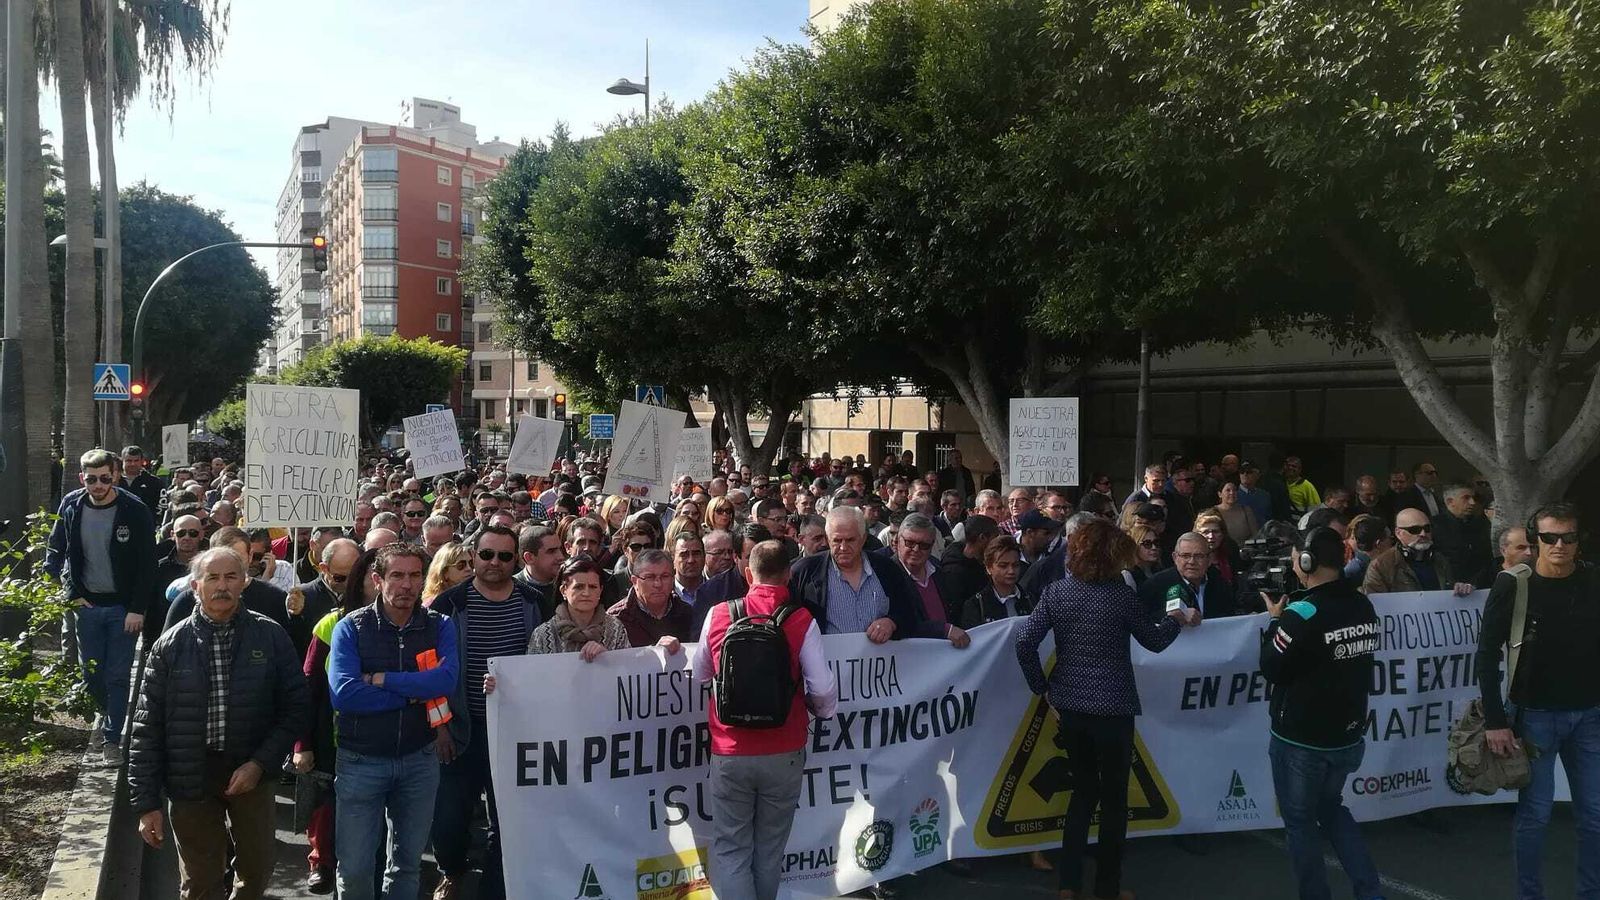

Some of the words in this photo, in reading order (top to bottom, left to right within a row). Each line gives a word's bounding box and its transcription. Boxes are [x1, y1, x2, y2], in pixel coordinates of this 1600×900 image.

[250, 391, 341, 421] NUESTRA
[1018, 407, 1074, 421] NUESTRA
[407, 411, 448, 431] NUESTRA
[1012, 425, 1077, 439] AGRICULTURA
[247, 427, 358, 459] AGRICULTURA
[1052, 441, 1067, 451] EN
[1015, 455, 1058, 467] PELIGRO
[1061, 457, 1075, 468] DE
[247, 464, 274, 490] EN
[282, 465, 355, 494] PELIGRO
[247, 495, 272, 523] DE
[617, 670, 713, 721] NUESTR
[829, 655, 902, 702] LTURA
[1181, 675, 1222, 710] EN
[1369, 658, 1407, 696] DE
[1363, 701, 1452, 741] MATE!
[517, 740, 567, 786] EN
[583, 721, 711, 783] PELIGR
[812, 686, 979, 753] EXTINCIÓN
[1352, 767, 1431, 795] COEXPHAL
[995, 775, 1016, 817] PRECIOS
[1217, 798, 1257, 811] ASAJA
[1014, 821, 1043, 833] CRISIS
[913, 832, 942, 852] UPA
